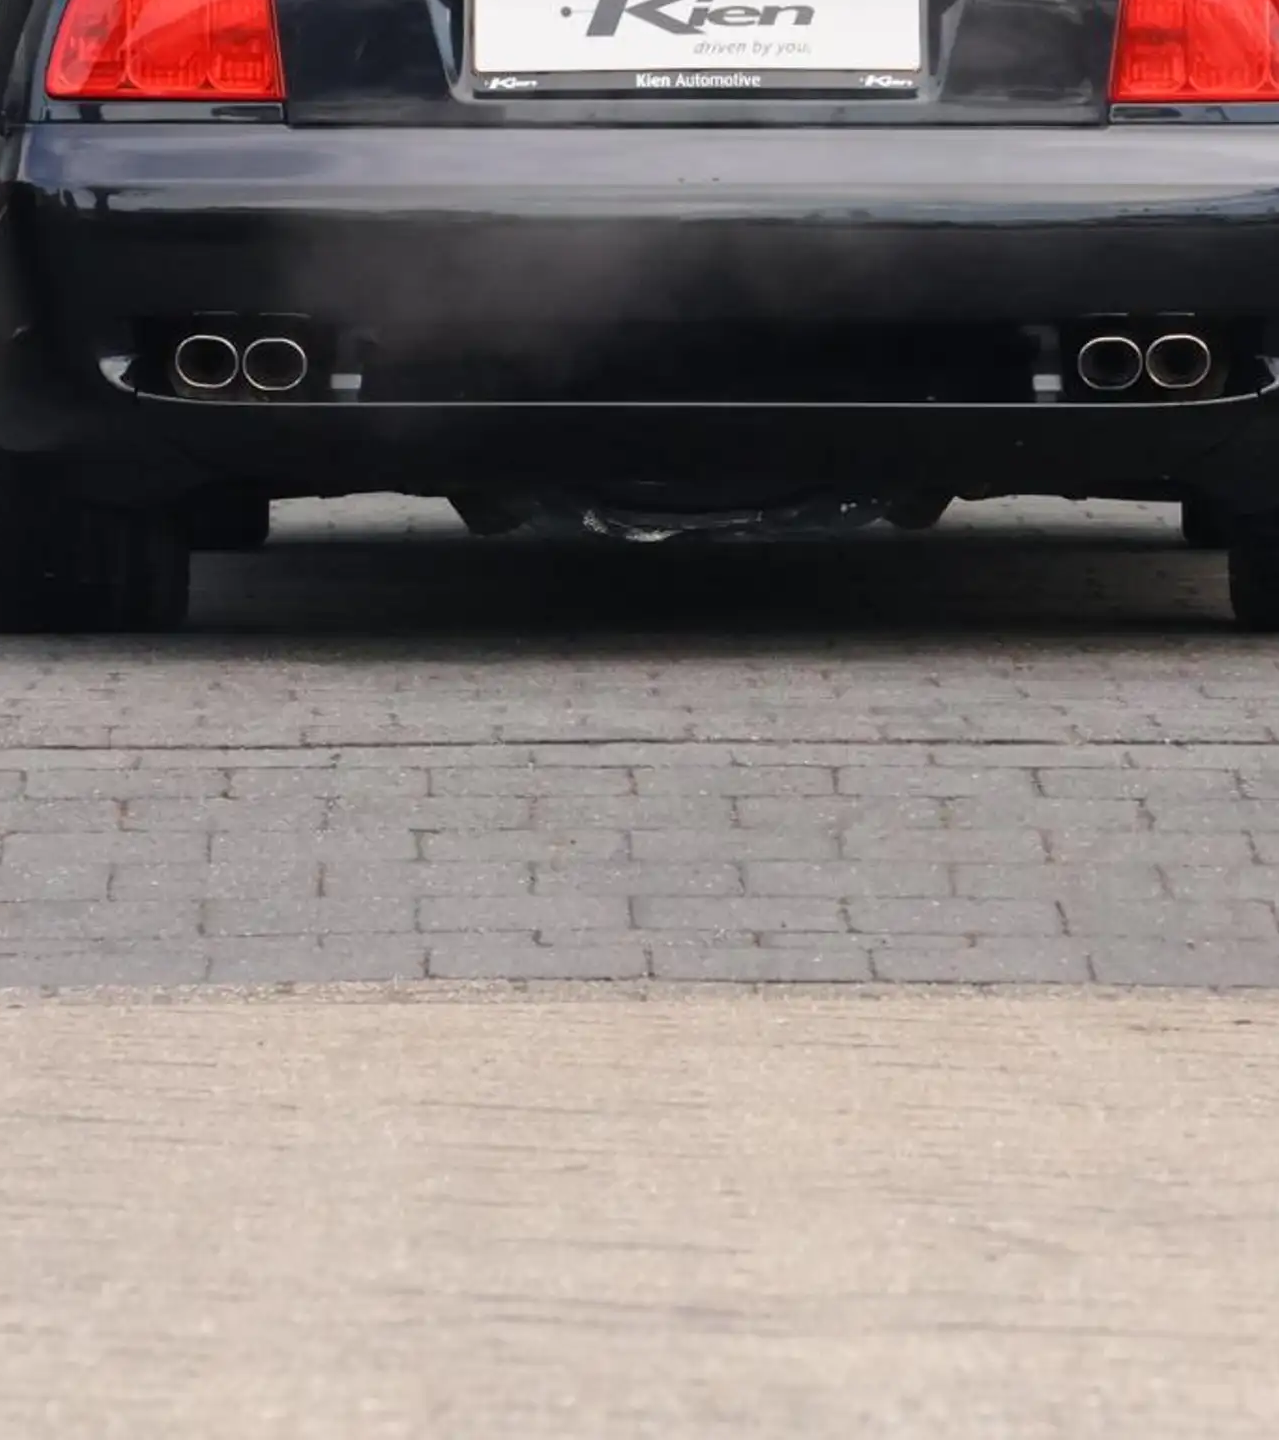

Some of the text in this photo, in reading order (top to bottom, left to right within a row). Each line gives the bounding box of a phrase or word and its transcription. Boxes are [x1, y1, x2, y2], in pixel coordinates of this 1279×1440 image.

[692, 39, 747, 55] driven
[751, 39, 773, 57] by
[635, 71, 762, 88] Kien Automotive
